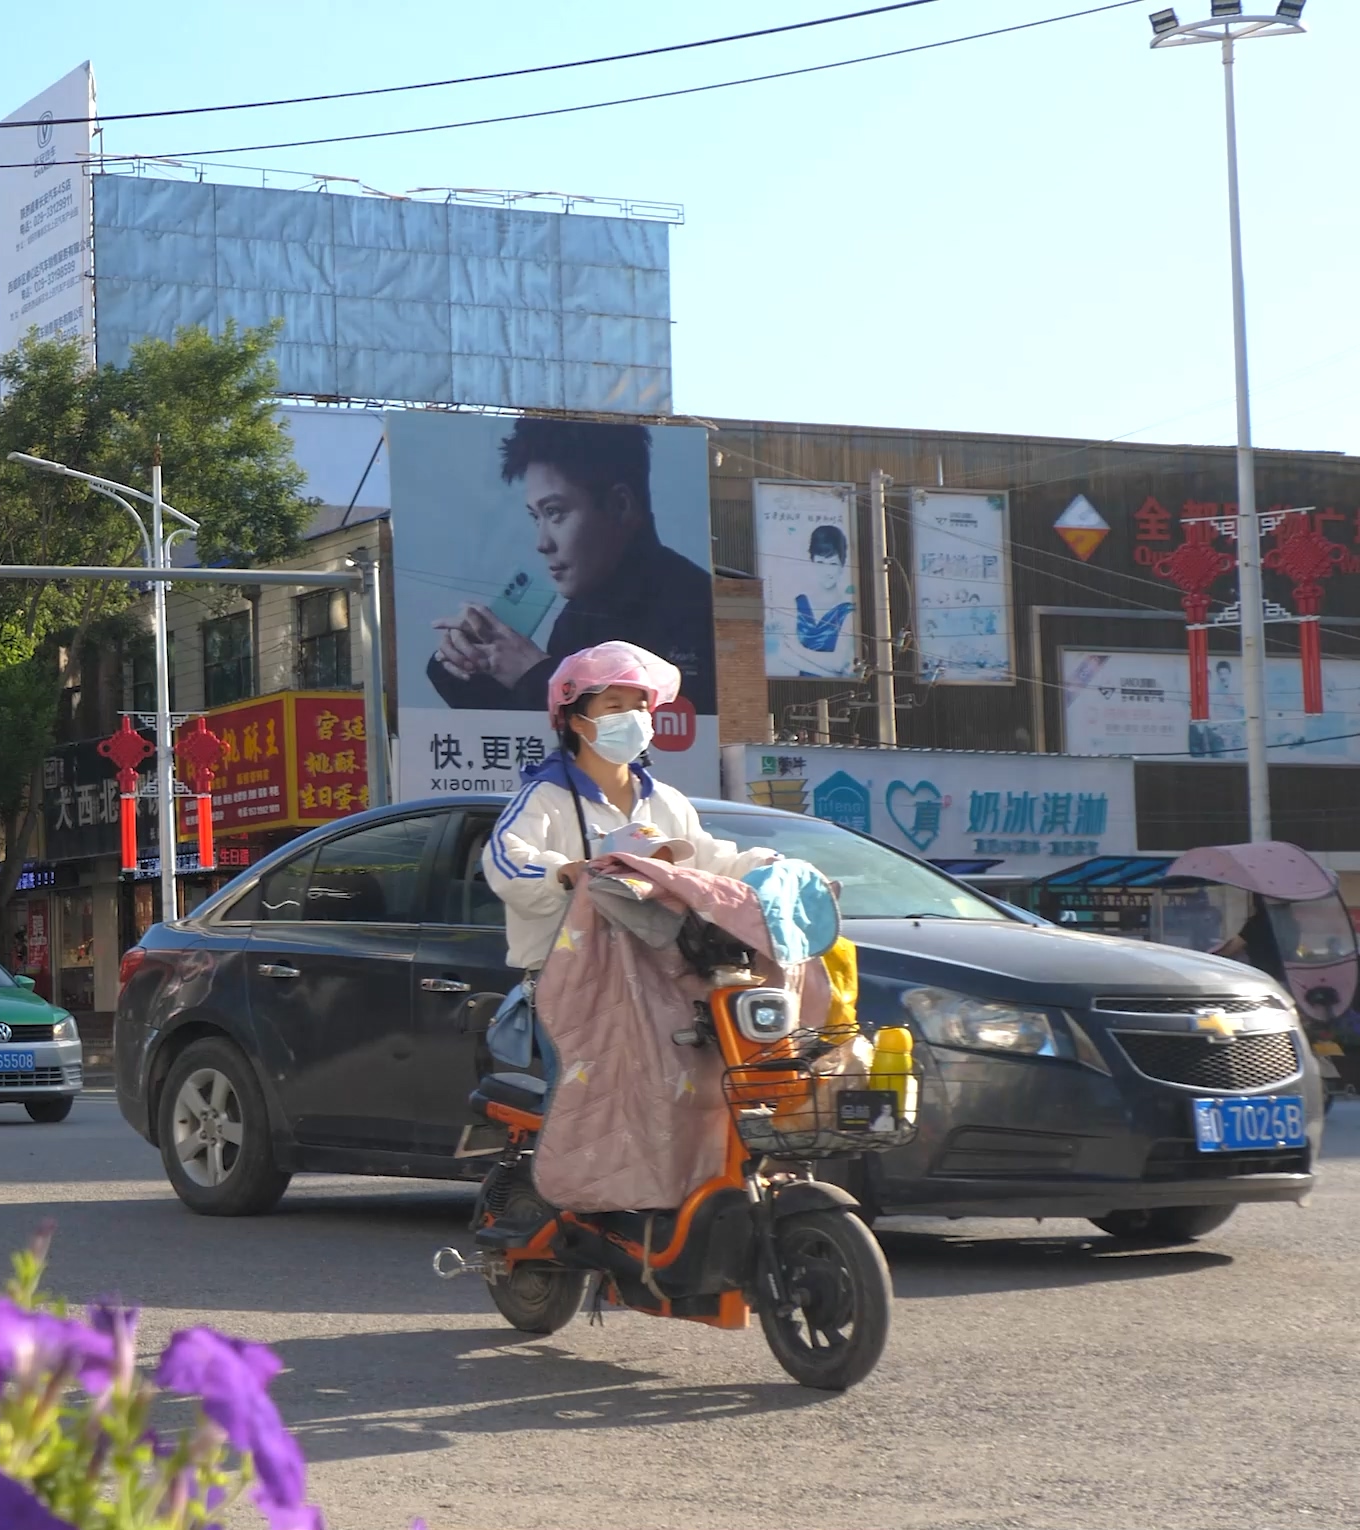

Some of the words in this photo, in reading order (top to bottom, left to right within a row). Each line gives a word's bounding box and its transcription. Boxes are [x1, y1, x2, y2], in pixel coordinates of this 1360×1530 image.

[316, 709, 367, 741] 宫廷
[304, 749, 368, 778] 桃酥
[500, 780, 514, 792] 12
[966, 790, 1108, 835] 奶冰淇淋
